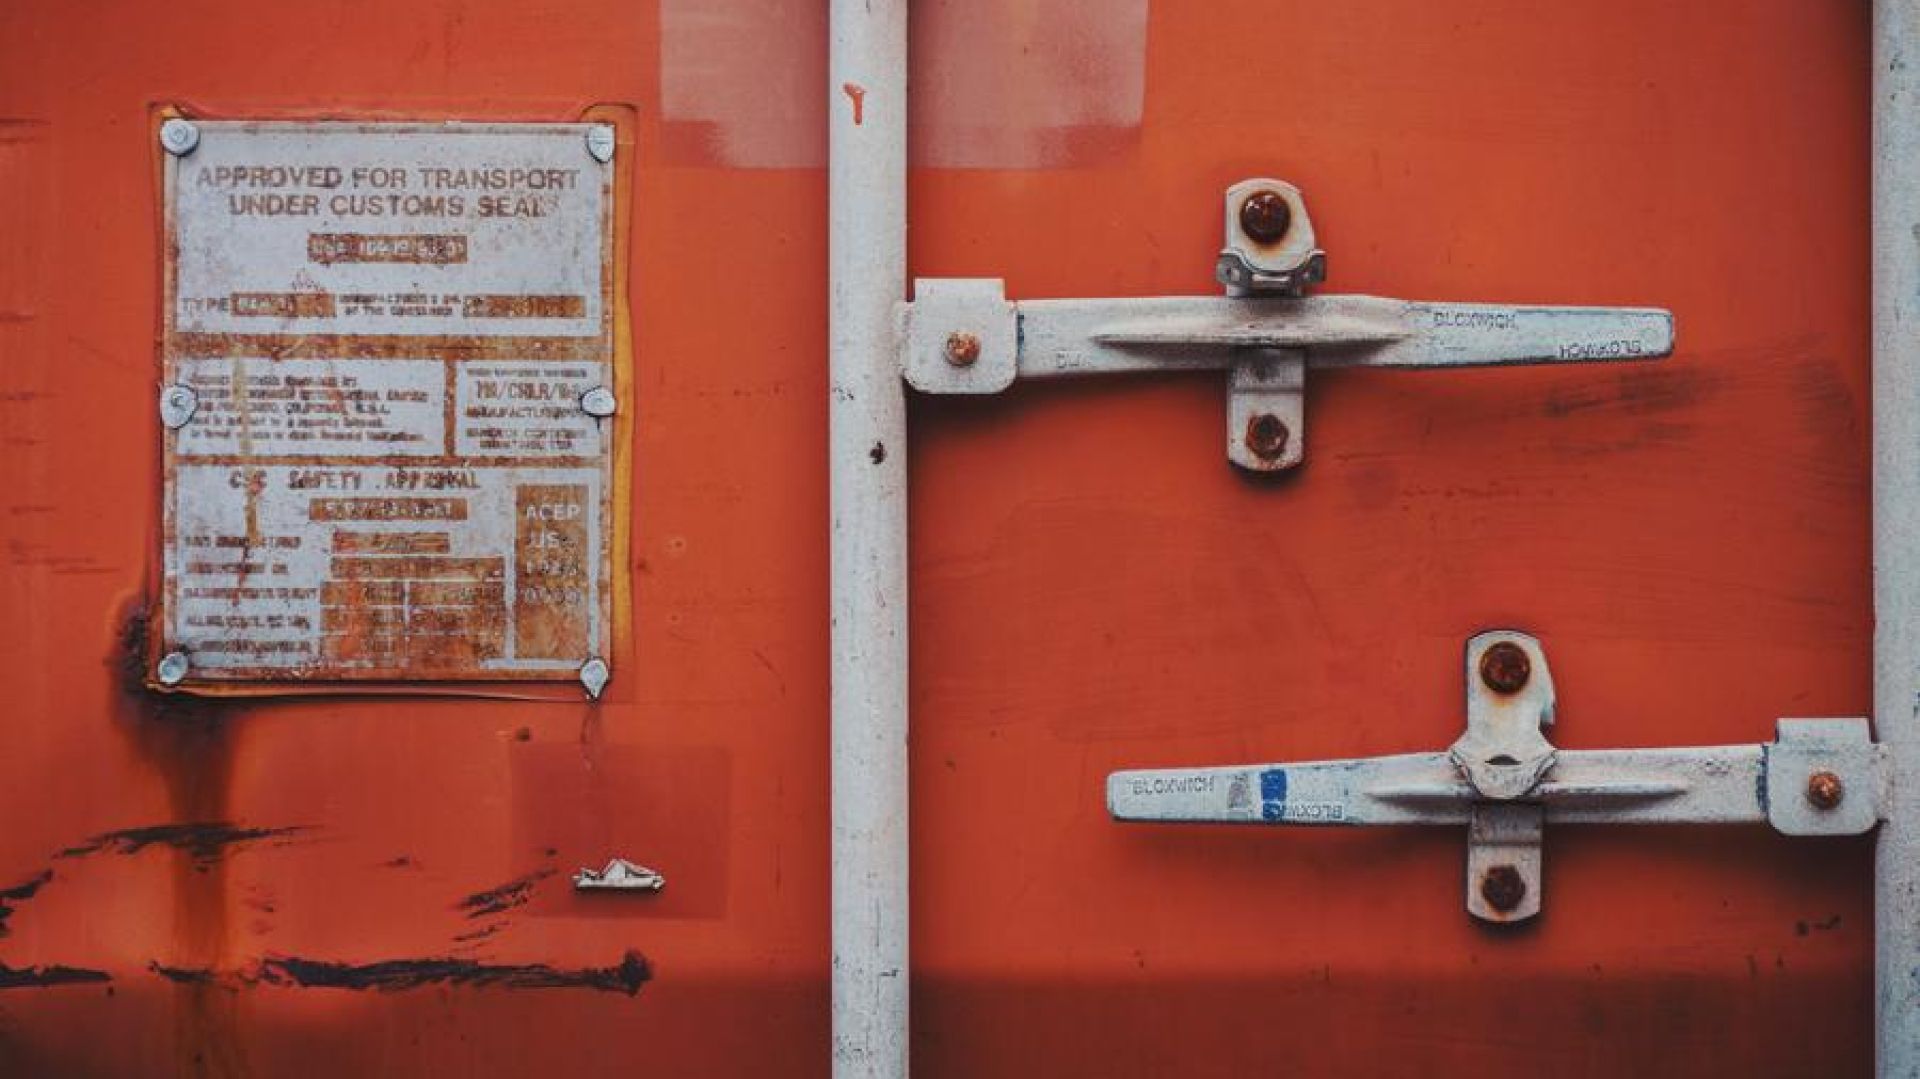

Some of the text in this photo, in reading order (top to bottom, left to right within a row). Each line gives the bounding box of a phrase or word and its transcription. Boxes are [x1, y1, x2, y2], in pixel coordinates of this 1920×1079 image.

[197, 166, 580, 191] APPROVED FOR TRANSPORT
[229, 195, 319, 217] UNDER
[330, 195, 464, 217] CUSTOMS
[182, 297, 230, 313] TYPE
[290, 470, 361, 489] SAFETY
[527, 504, 581, 521] ACEP
